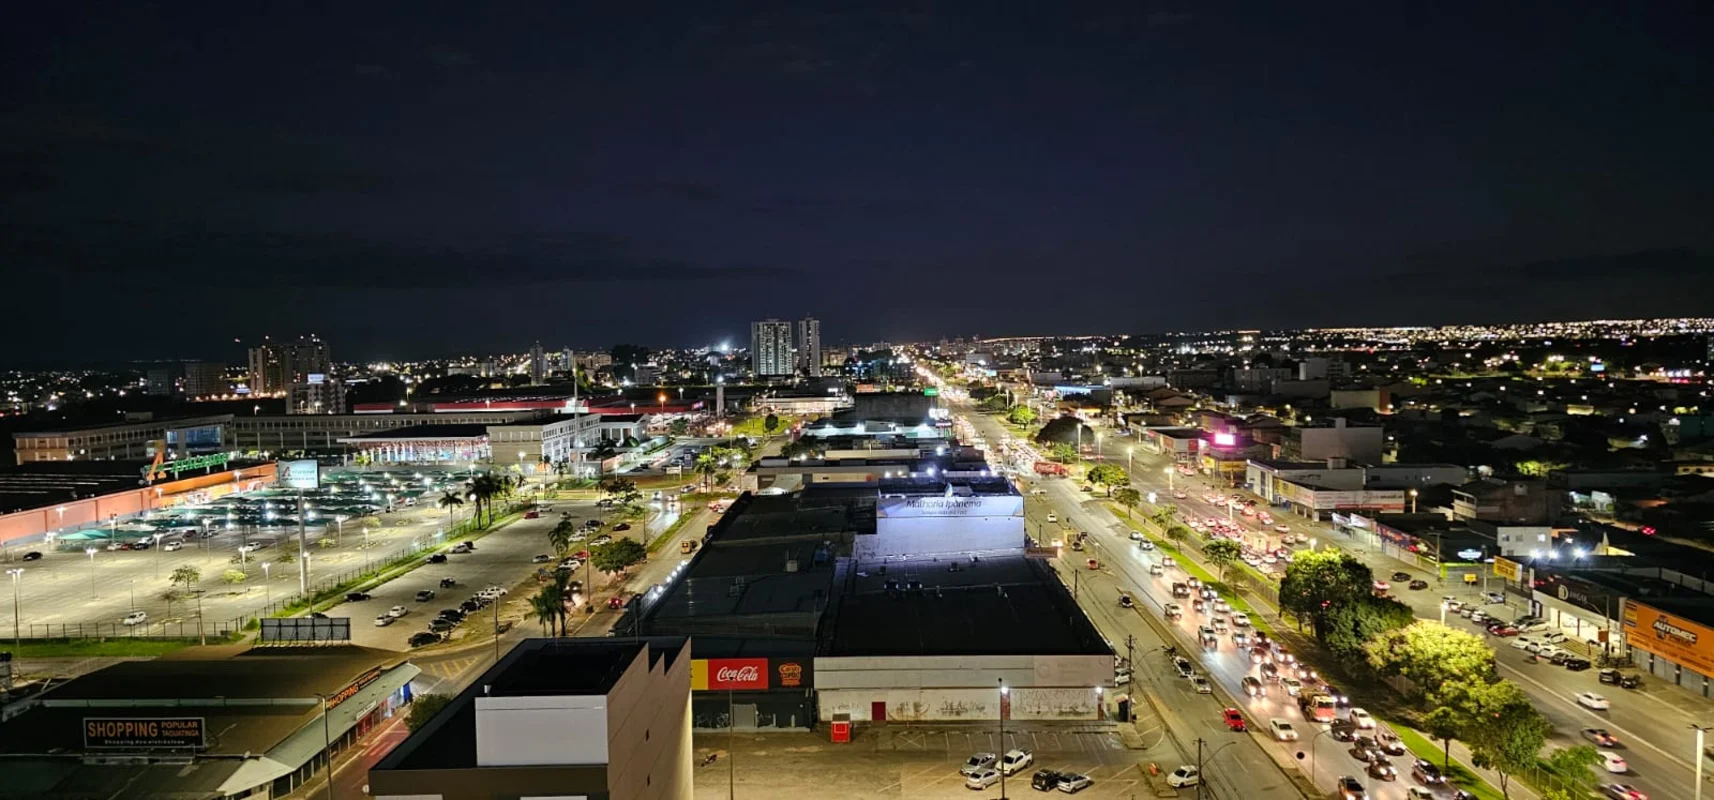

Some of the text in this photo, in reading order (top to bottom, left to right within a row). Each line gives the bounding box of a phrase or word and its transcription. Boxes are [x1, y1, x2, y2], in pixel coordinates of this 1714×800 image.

[1653, 620, 1697, 643] AUTOMEC
[88, 722, 158, 737] SHOPPING
[161, 721, 198, 729] POPULAR
